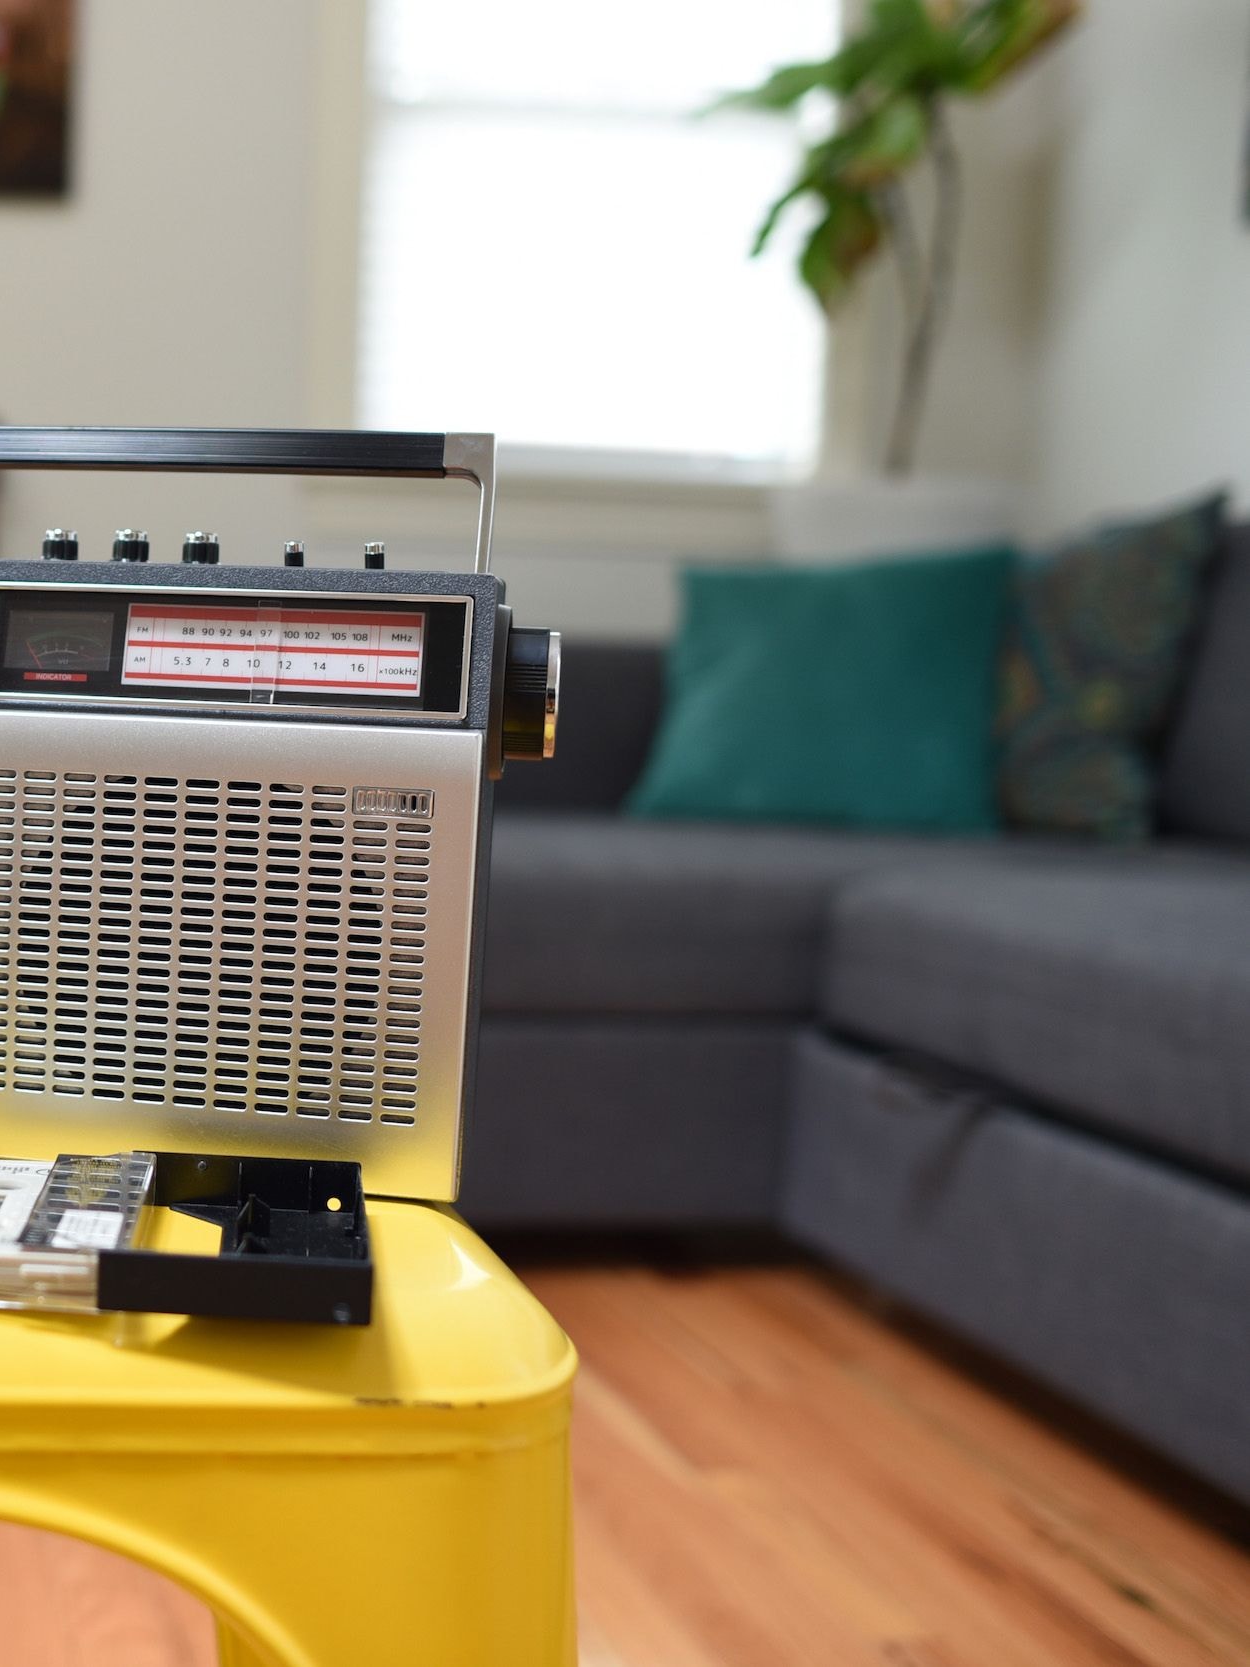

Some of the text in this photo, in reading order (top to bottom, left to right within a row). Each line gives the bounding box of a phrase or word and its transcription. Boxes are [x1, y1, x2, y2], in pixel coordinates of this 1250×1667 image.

[137, 626, 413, 642] FM 88 90 92 94 97 100 102 105 108 MHz
[174, 656, 192, 666] 5.3
[205, 657, 212, 667] 7
[222, 658, 230, 668] 8
[247, 659, 261, 669] 10
[278, 660, 292, 670] 12
[313, 662, 327, 671] 14
[351, 663, 365, 673] 16
[35, 673, 72, 681] INDICATOR
